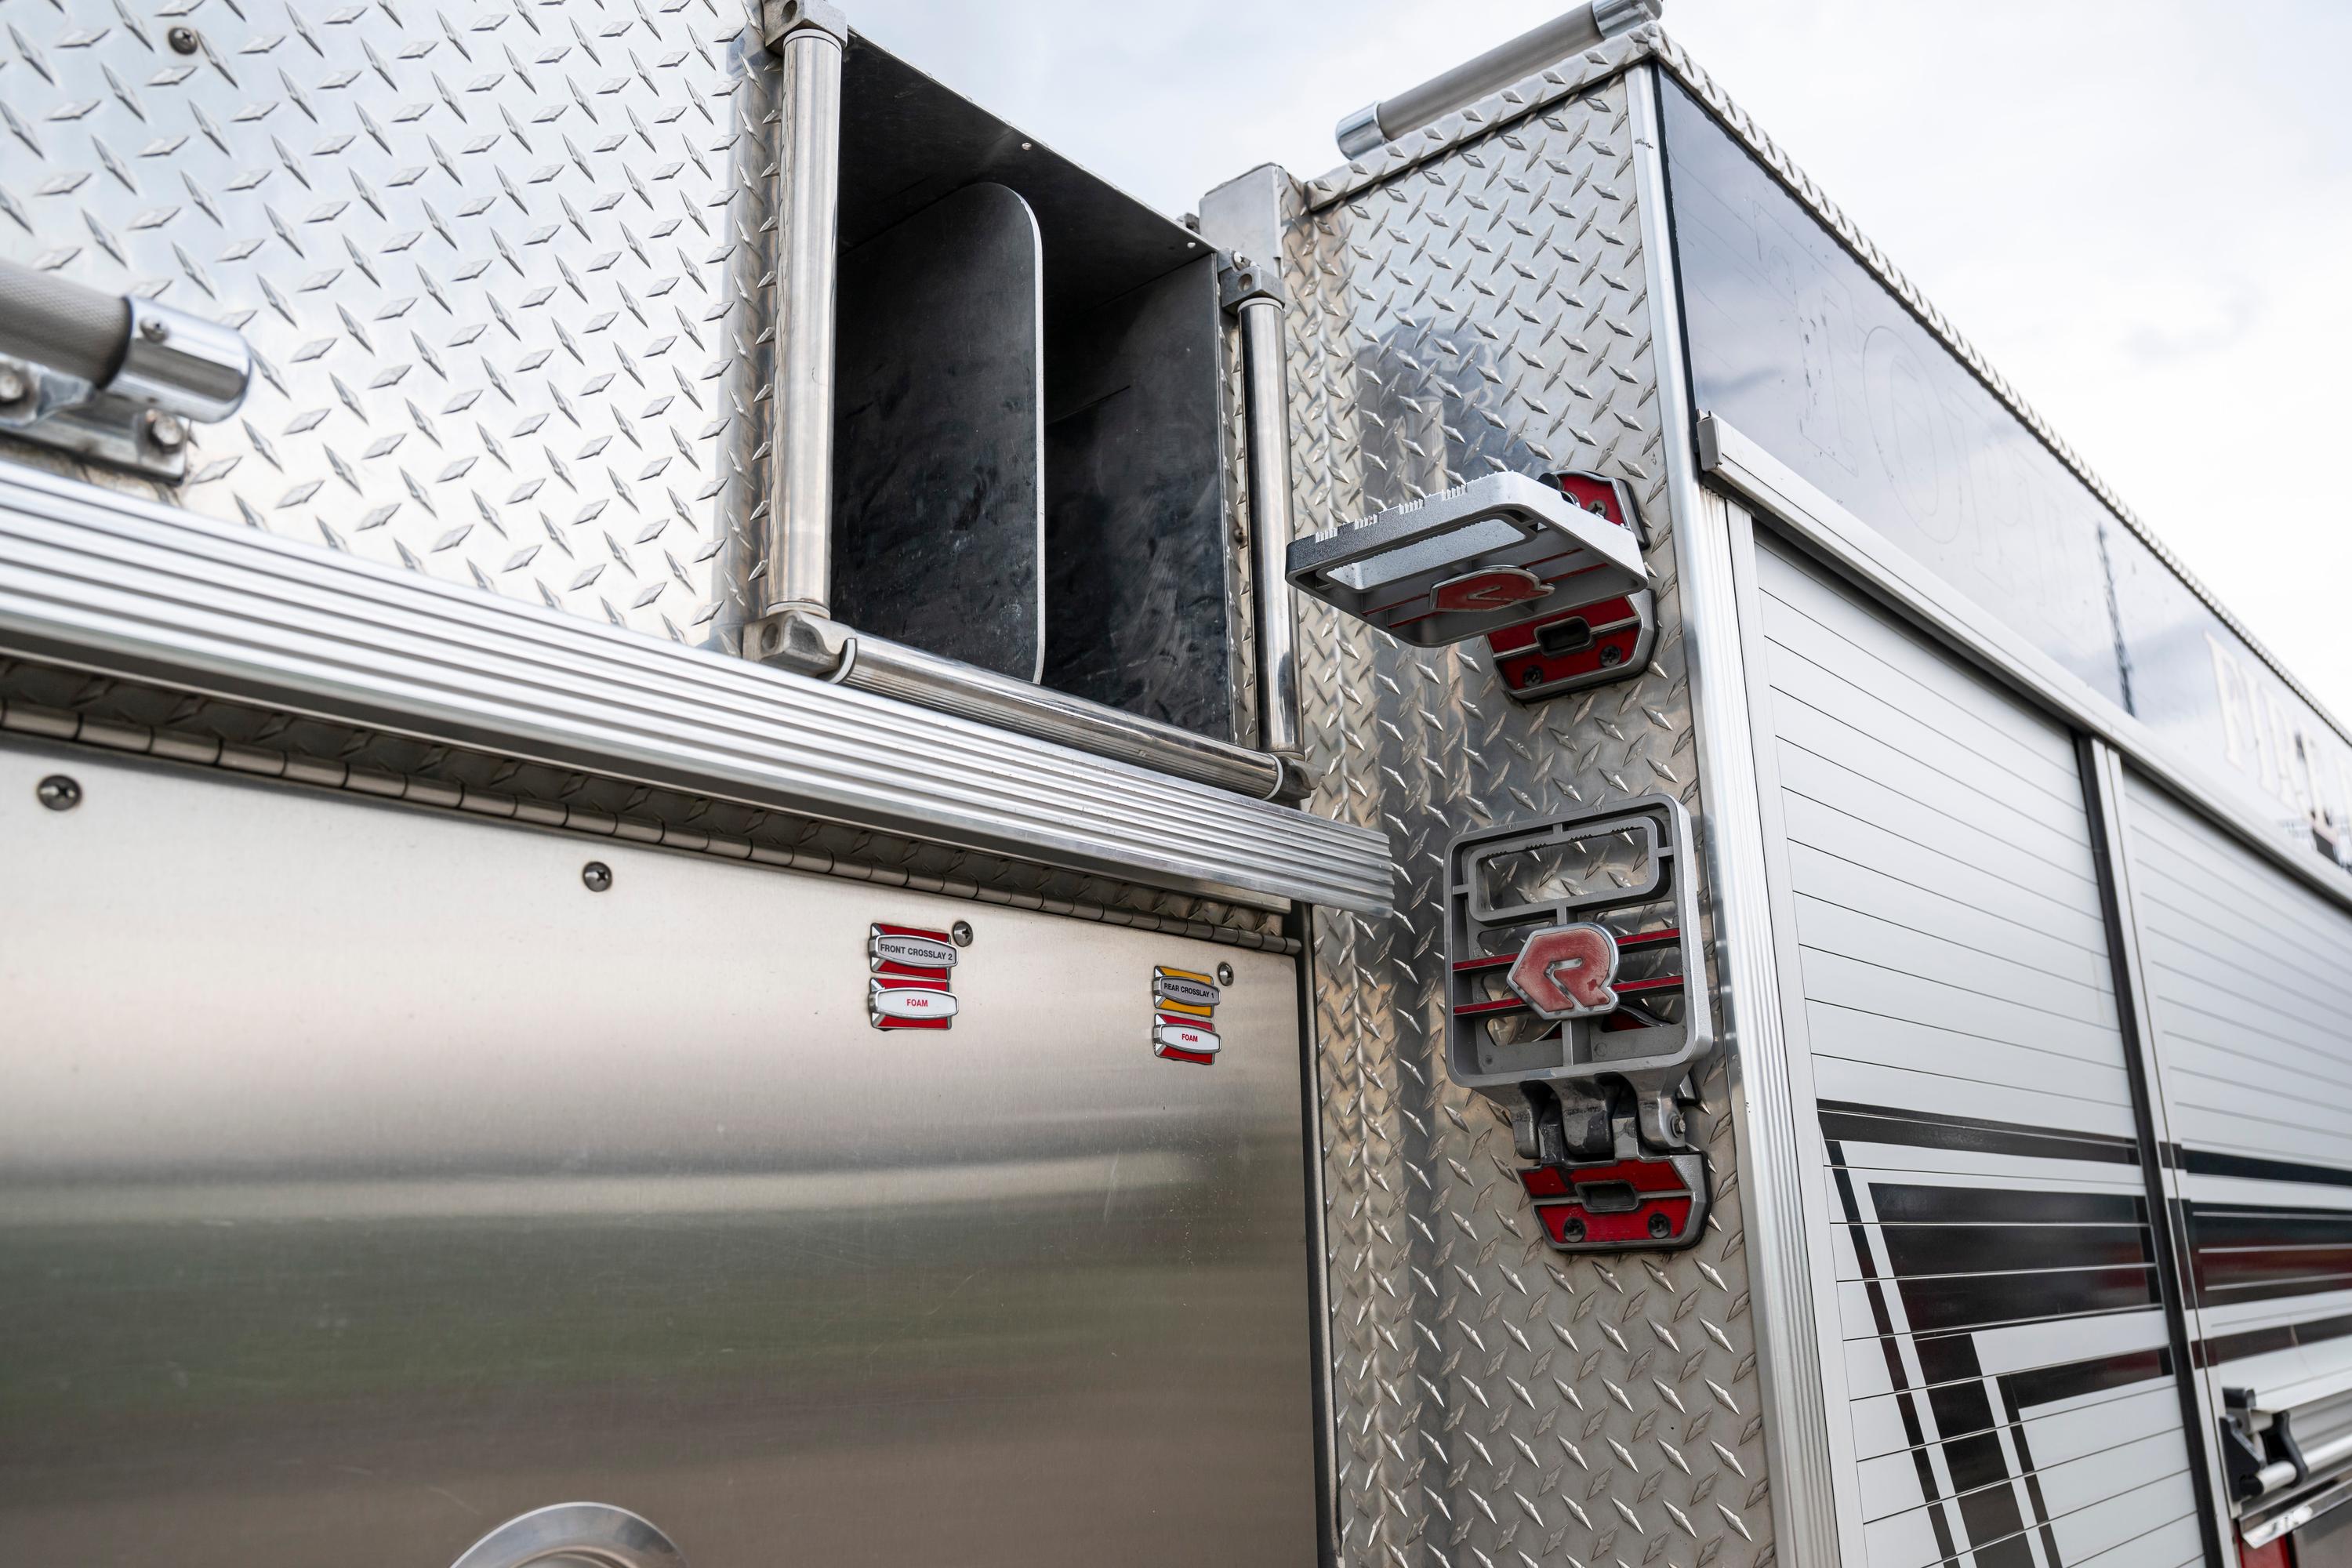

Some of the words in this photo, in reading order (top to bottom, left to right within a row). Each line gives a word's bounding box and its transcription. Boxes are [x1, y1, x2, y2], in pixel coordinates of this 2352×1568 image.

[880, 943, 906, 954] FRONT
[907, 947, 946, 960] CROSSLAY
[1163, 982, 1179, 991] REAR
[1181, 985, 1210, 997] CROSSLAY
[1181, 1033, 1198, 1042] FOAM
